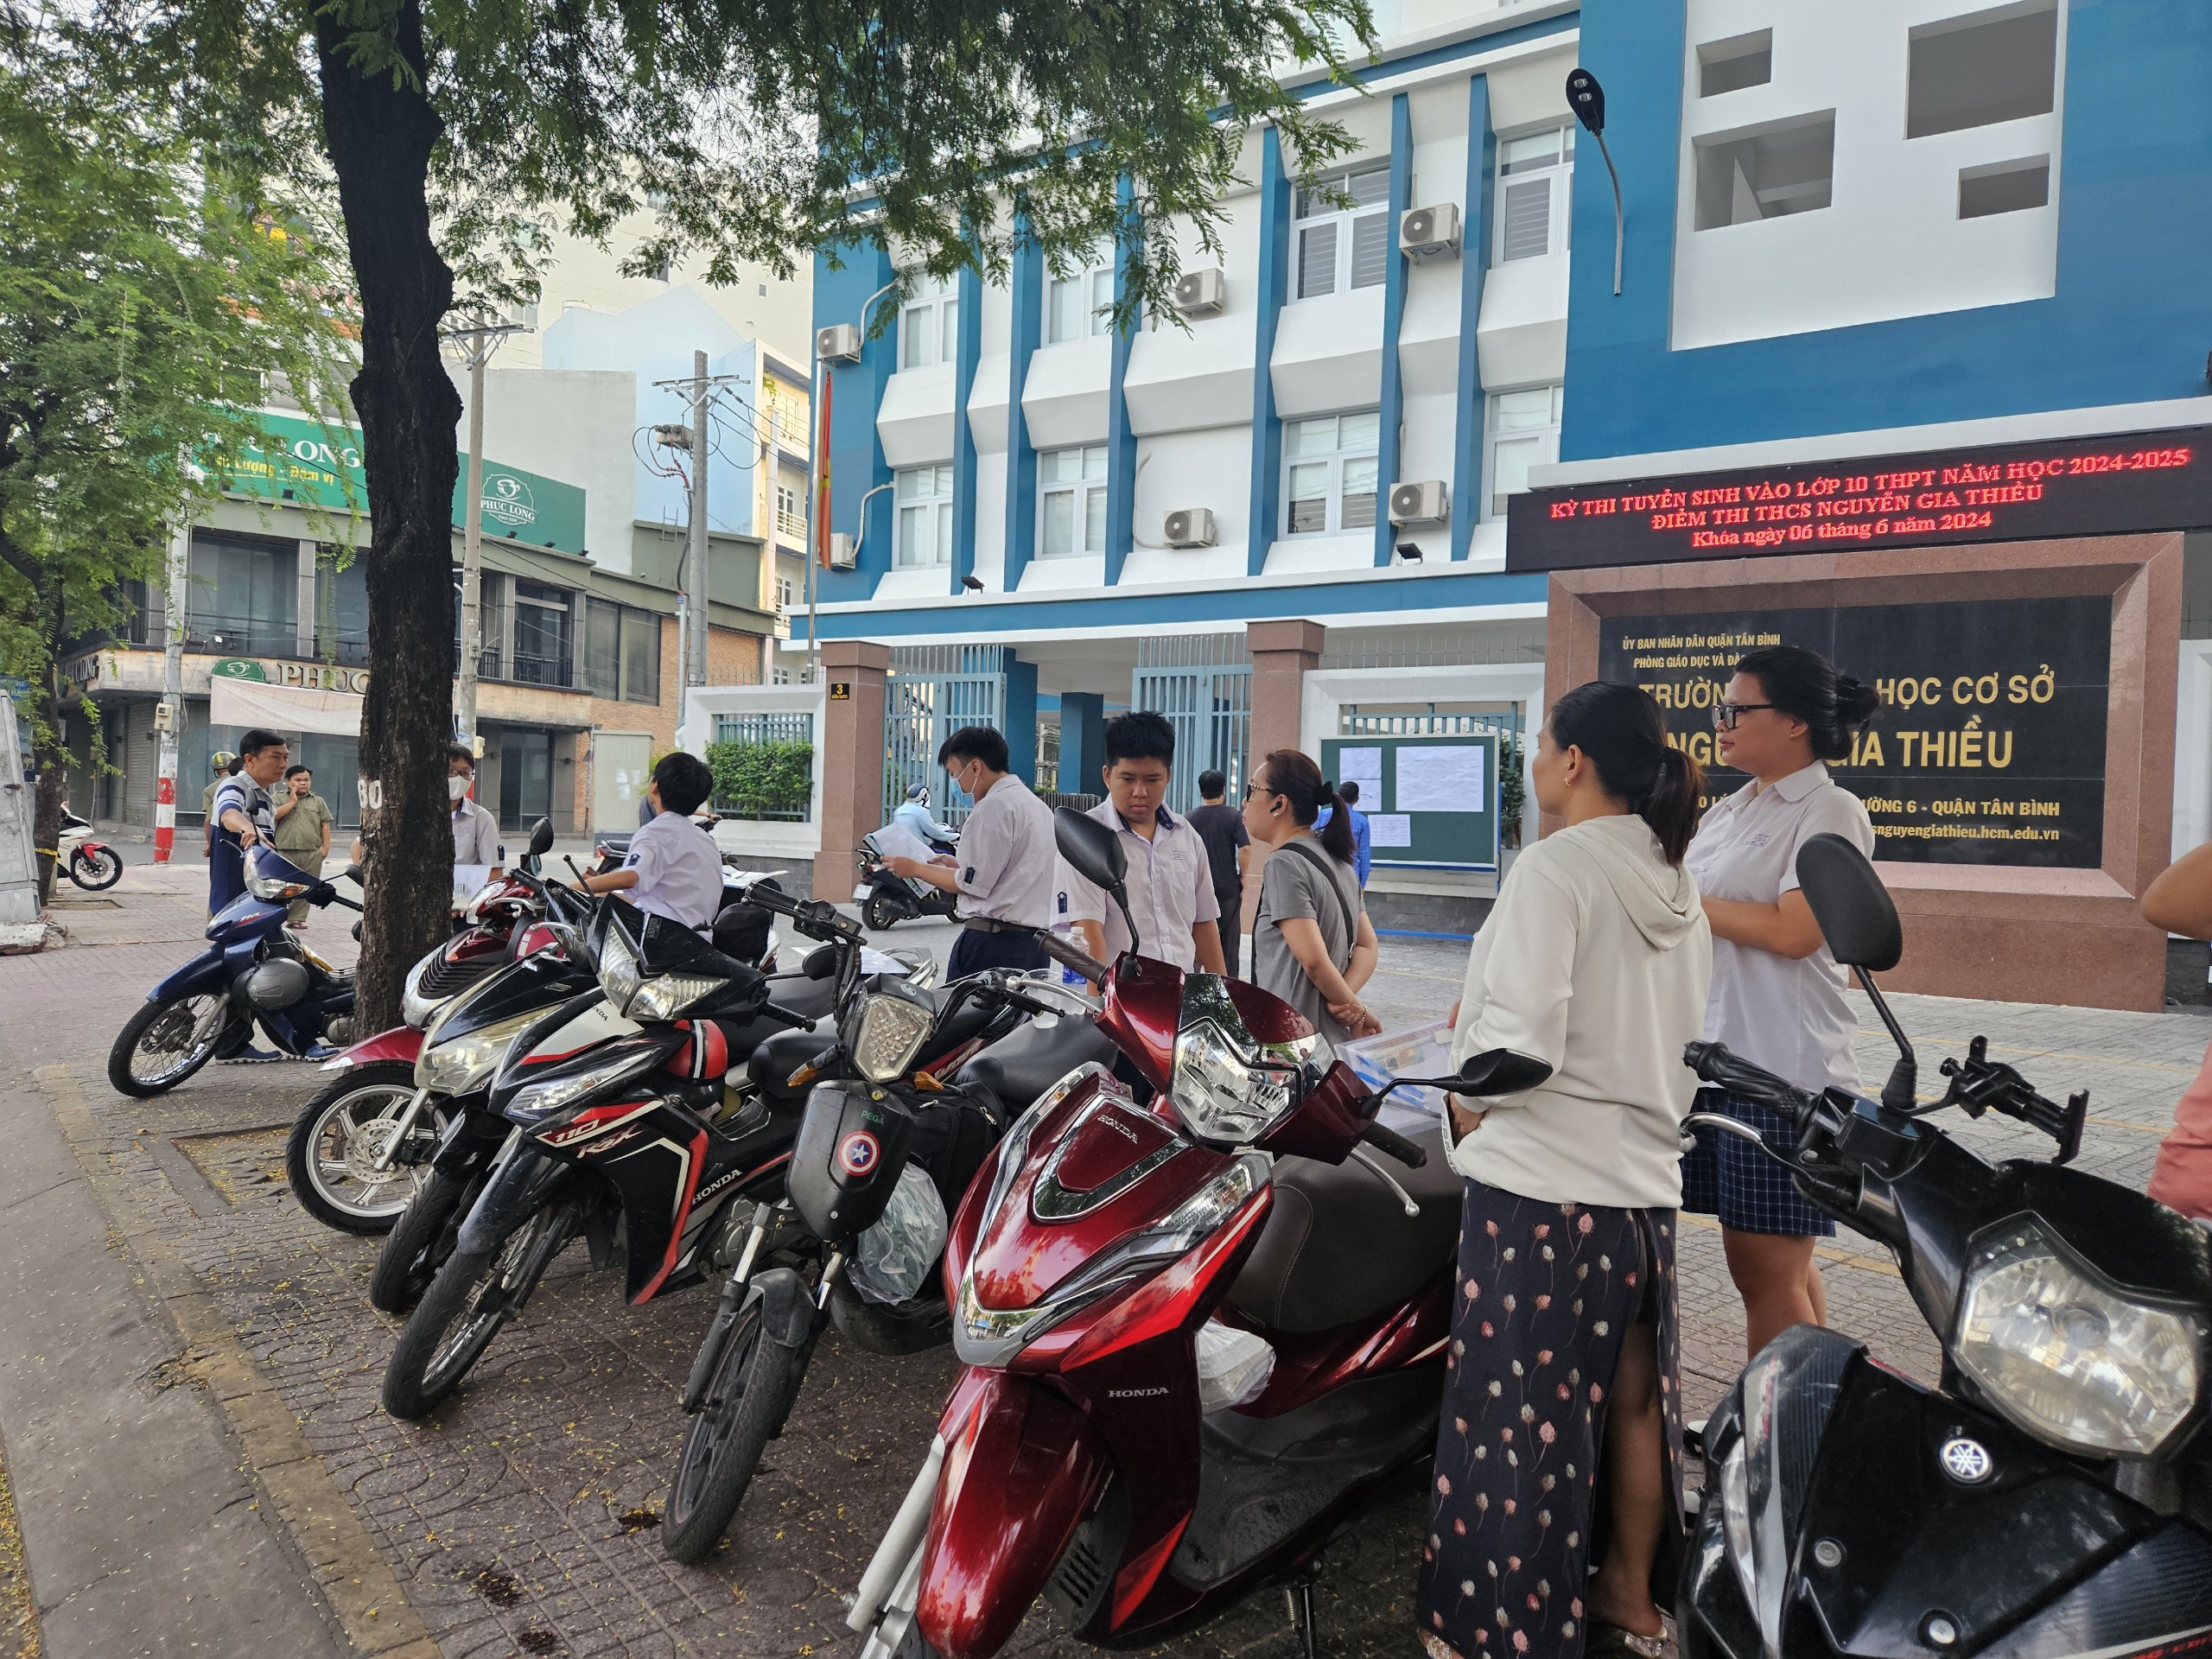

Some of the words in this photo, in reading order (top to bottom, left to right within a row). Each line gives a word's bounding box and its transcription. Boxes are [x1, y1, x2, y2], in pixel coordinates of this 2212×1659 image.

[1583, 499, 1617, 516] THI
[1691, 486, 1741, 506] SINH
[1796, 476, 1841, 497] LỚP
[1845, 476, 1869, 493] 10
[1874, 470, 1936, 490] THPT
[1942, 462, 2001, 485] NĂM
[2006, 458, 2064, 480] HỌC
[2069, 448, 2191, 475] 2024-2025
[509, 505, 536, 521] LONG
[1713, 506, 1749, 525] THI
[1754, 502, 1812, 522] THCS
[1915, 491, 1961, 510] GIA
[1693, 530, 1740, 547] Khóa
[1743, 526, 1786, 547] ngày
[1789, 523, 1813, 541] 06
[1817, 521, 1872, 539] tháng
[1874, 518, 1889, 534] 6
[1892, 516, 1936, 534] năm
[1939, 510, 1993, 531] 2024
[1623, 635, 1635, 651] ỦY
[1637, 638, 1656, 650] BAN
[1658, 634, 1683, 649] NHÂN
[1686, 633, 1705, 648] DÂN
[1707, 632, 1733, 649] QUẬN
[1736, 632, 1754, 646] TÂN
[1757, 632, 1781, 645] BÌNH
[1634, 654, 1664, 669] PHÒNG
[1667, 653, 1688, 668] GIÁO
[1690, 655, 1710, 669] DỤC
[1713, 652, 1725, 666] VÀ
[1727, 652, 1745, 666] ĐÀ
[836, 683, 843, 695] 3
[1876, 677, 1942, 710] HỌC
[1952, 671, 1999, 705] CƠ
[2007, 664, 2055, 703] SỞ
[1896, 715, 2013, 768] THIỀU
[1860, 797, 1903, 813] ƯỜNG
[1906, 800, 1917, 814] 6
[1932, 798, 1976, 817] QUẬN
[1980, 798, 2014, 816] TÂN
[2019, 799, 2060, 817] BÌNH
[861, 1109, 884, 1125] PEGA
[1097, 1114, 1138, 1144] HONDA
[555, 1118, 601, 1142] 110
[691, 1169, 743, 1206] HONDA
[1108, 1387, 1170, 1398] HONDA
